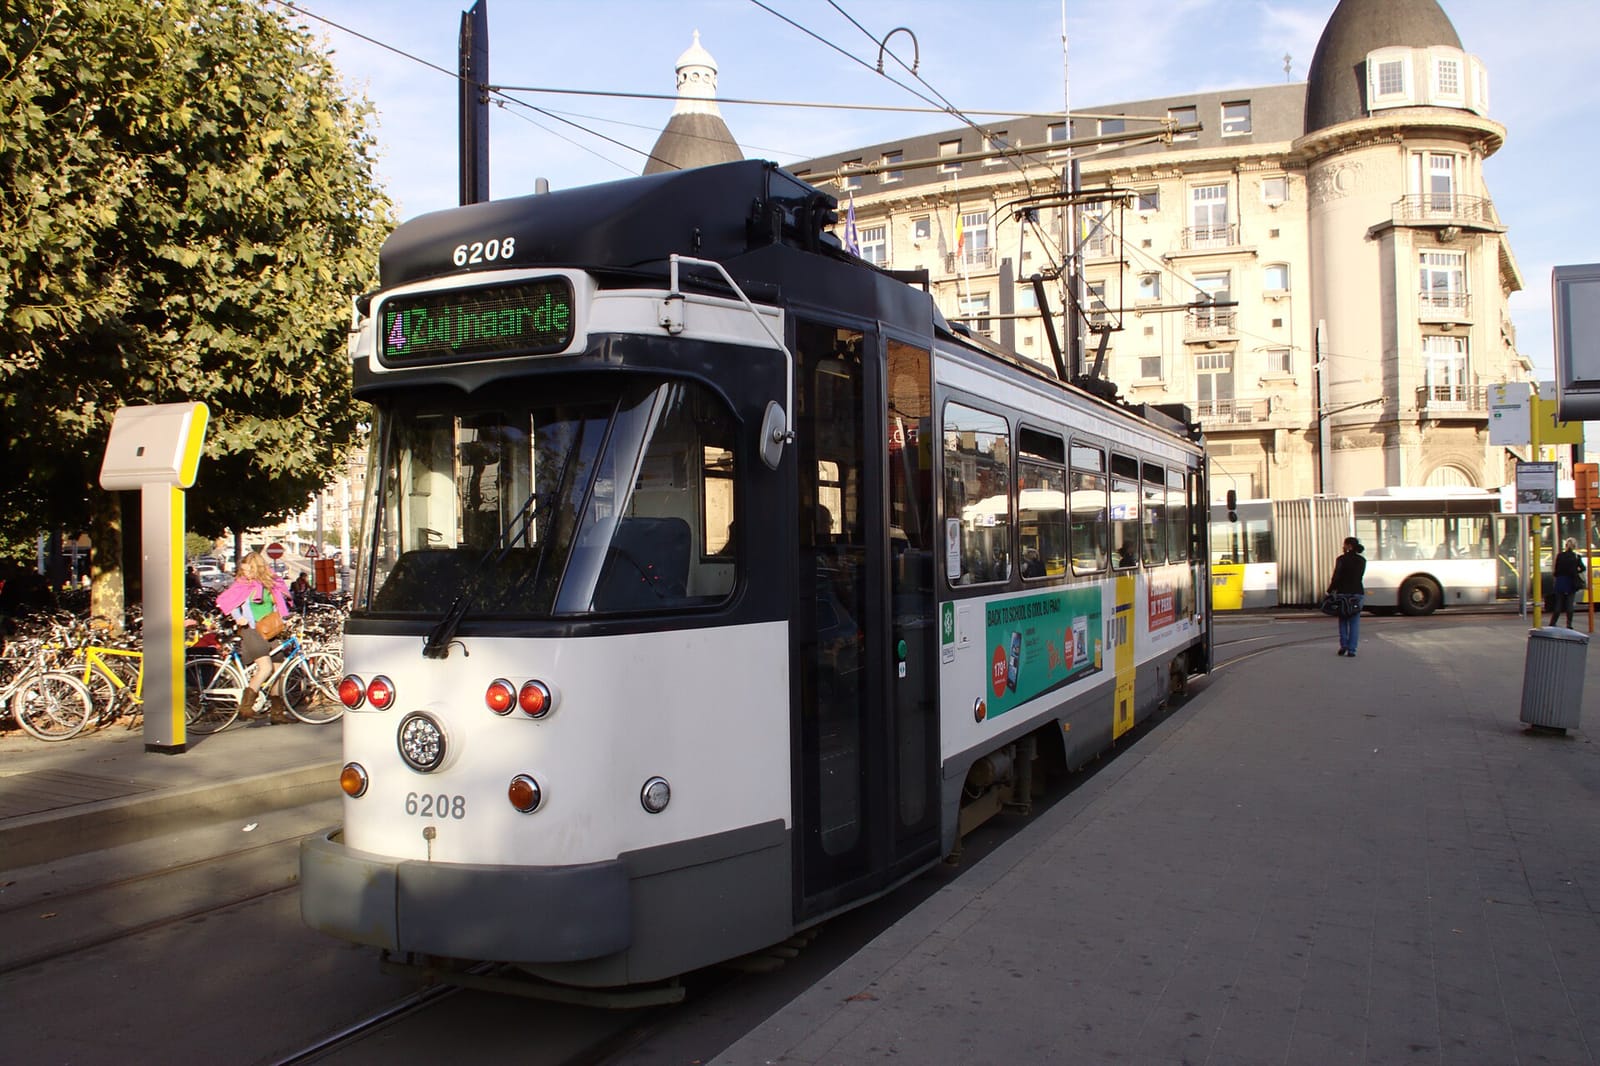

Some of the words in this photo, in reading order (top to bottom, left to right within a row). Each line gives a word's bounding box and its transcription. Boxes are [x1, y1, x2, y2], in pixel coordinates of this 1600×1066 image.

[453, 237, 516, 266] 6208
[386, 312, 407, 349] 4
[411, 293, 570, 349] Zwijnaarde
[404, 791, 466, 820] 6208
